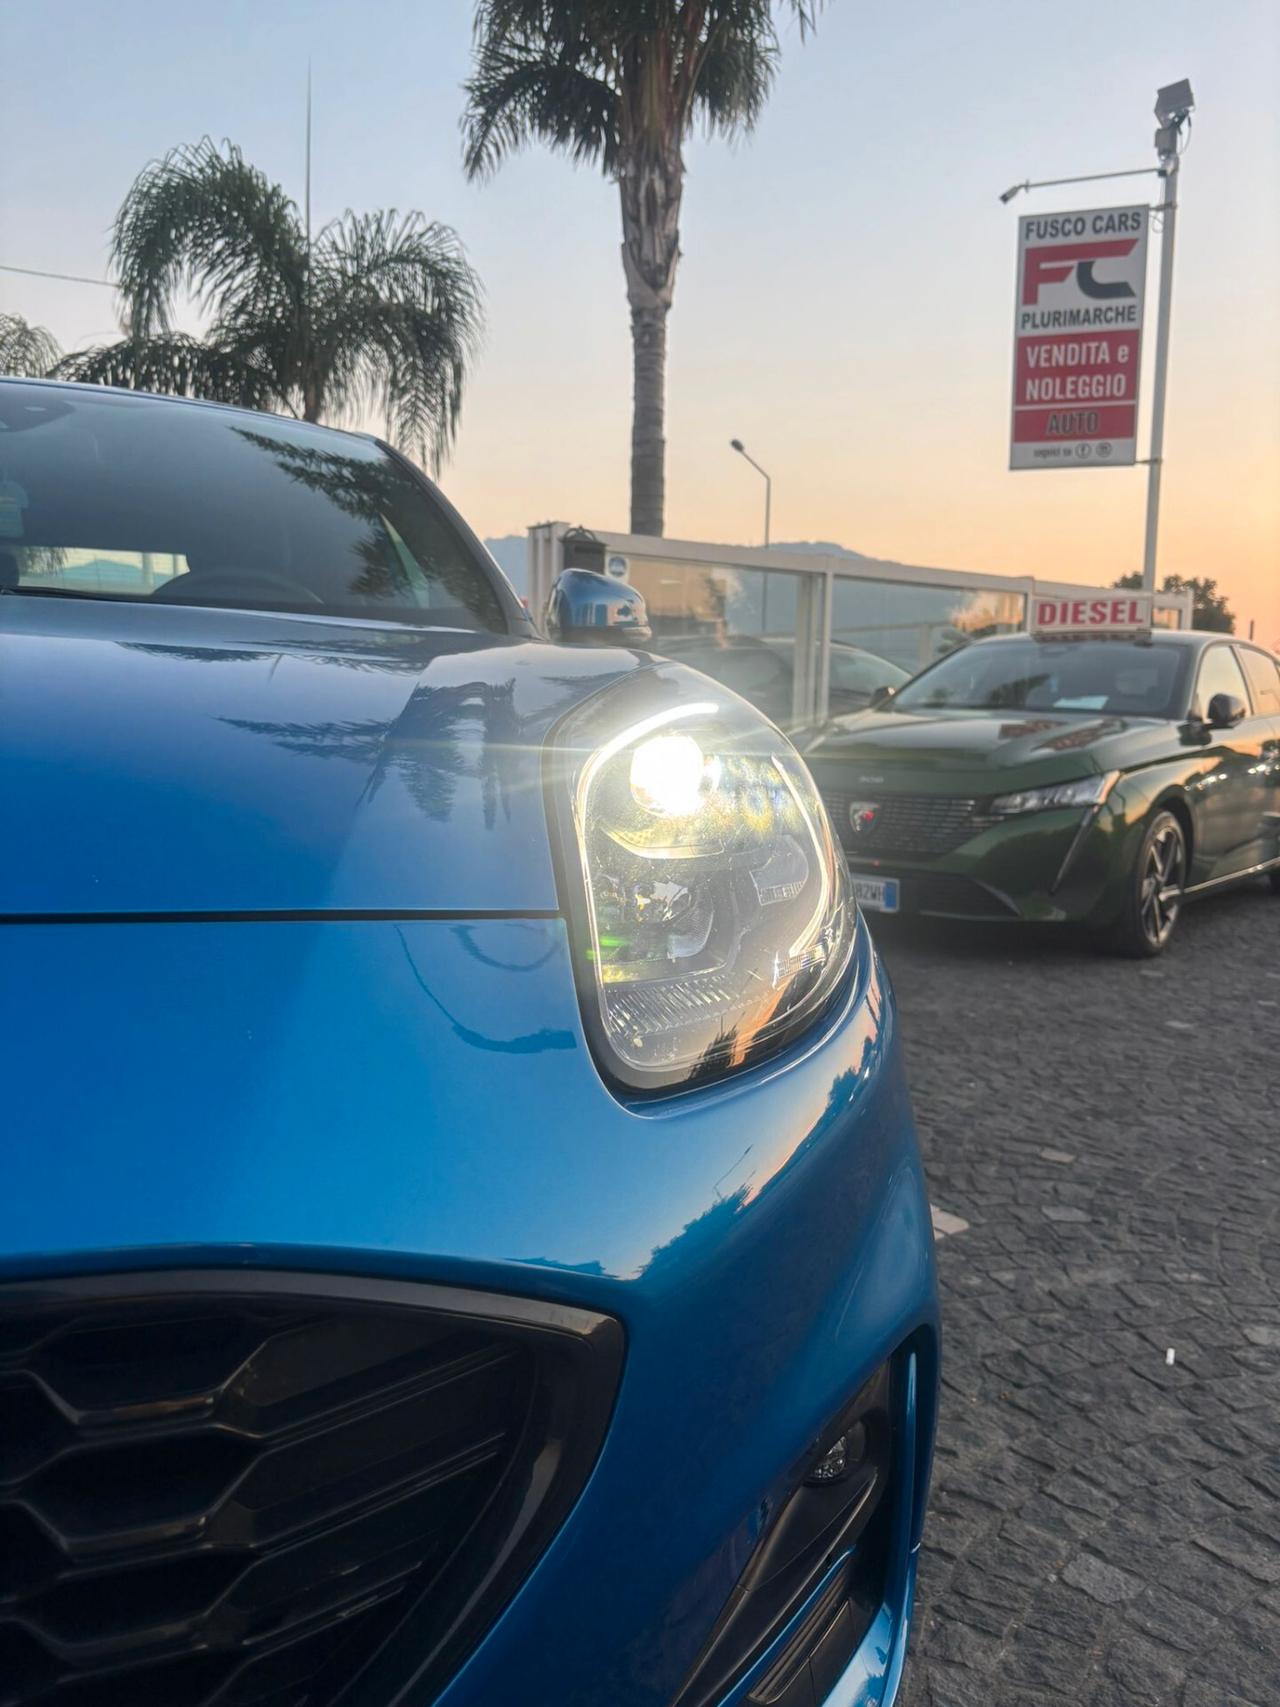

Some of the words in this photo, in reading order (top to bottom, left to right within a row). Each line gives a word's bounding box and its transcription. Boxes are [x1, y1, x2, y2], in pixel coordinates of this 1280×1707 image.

[1025, 217, 1086, 240] FUSCO
[1092, 212, 1141, 234] CARS
[1021, 305, 1136, 330] PLURIMARCHE
[1026, 342, 1110, 368] VENDITA
[1117, 345, 1129, 363] e
[1025, 374, 1126, 401] NOLEGGIO
[1047, 412, 1099, 435] AUTO
[1037, 600, 1144, 625] DIESEL
